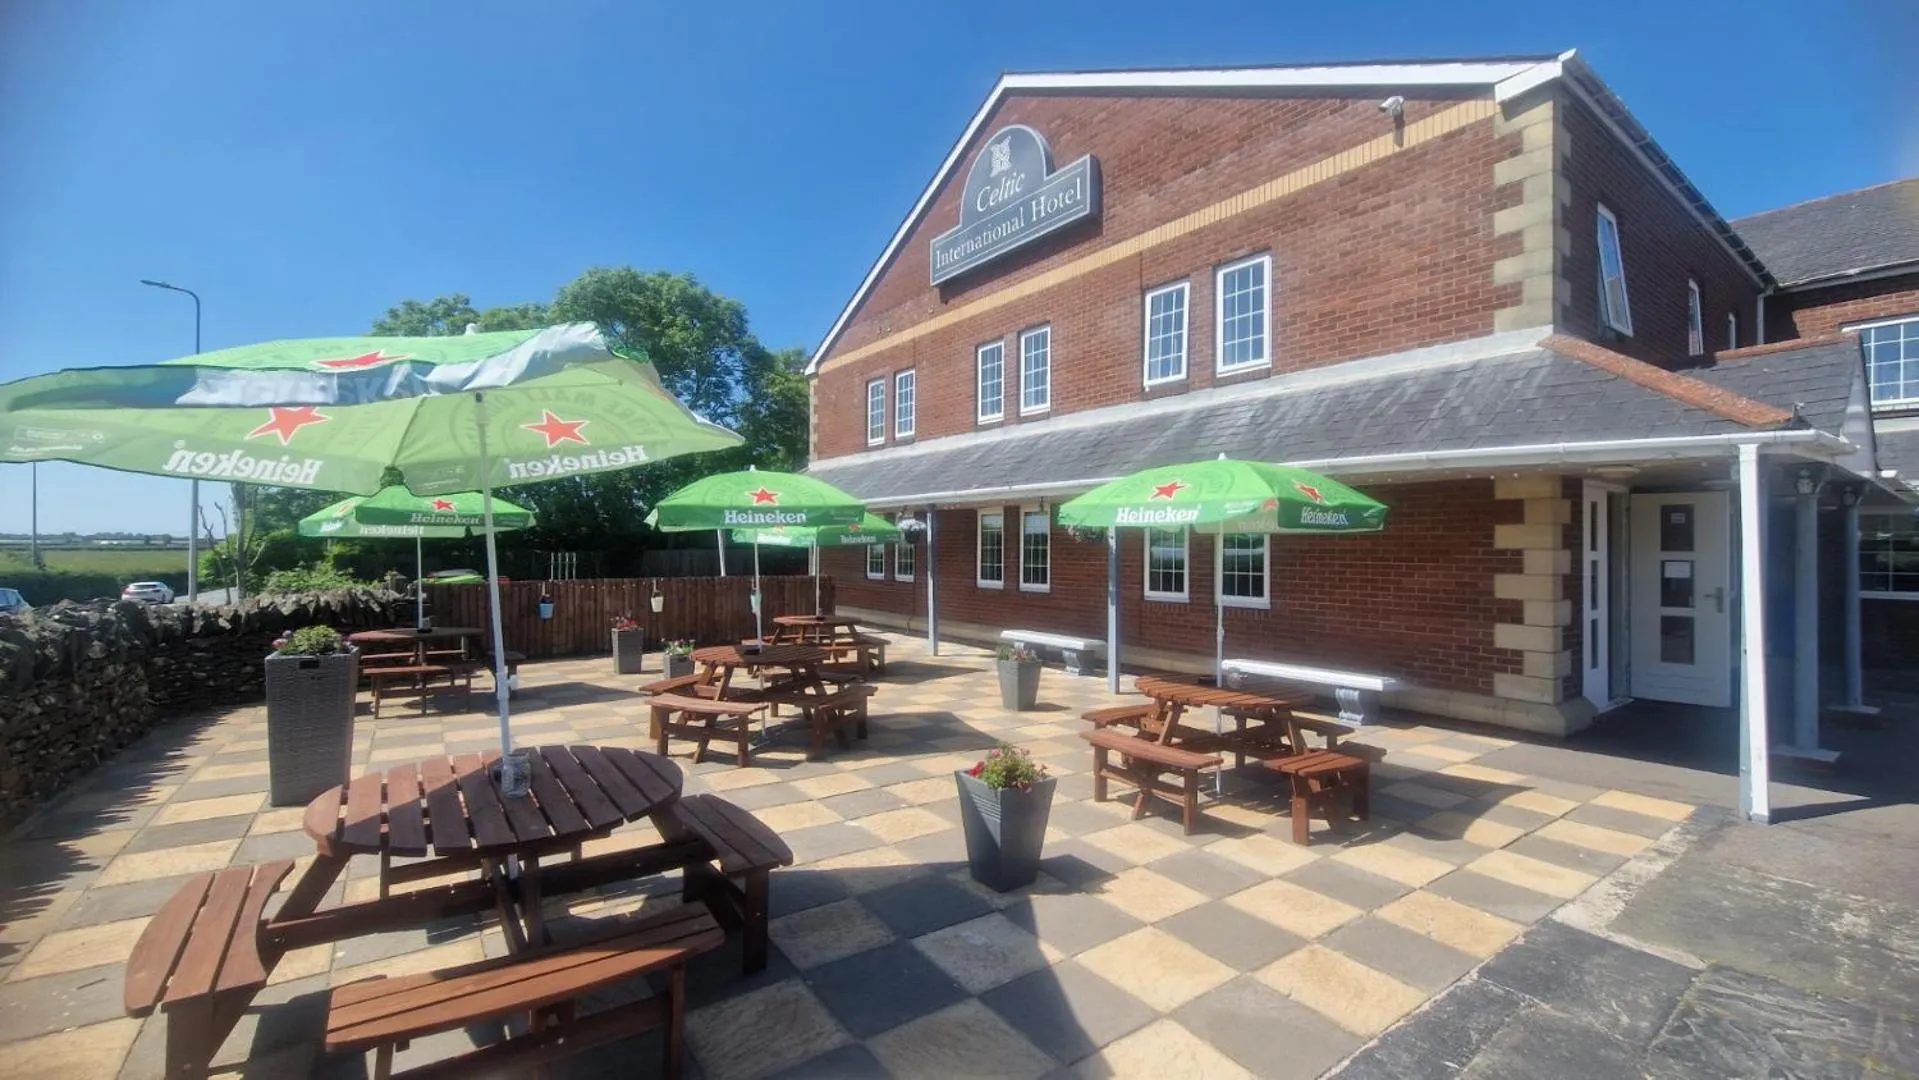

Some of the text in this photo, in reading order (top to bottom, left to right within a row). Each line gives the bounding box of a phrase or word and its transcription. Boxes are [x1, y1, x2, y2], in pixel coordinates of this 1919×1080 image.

[976, 172, 1025, 212] Celtic
[936, 178, 1081, 269] International Hotel
[410, 513, 480, 525] Heineken
[724, 509, 807, 525] Heineken
[1115, 506, 1200, 524] Heineken
[1301, 506, 1349, 525] Heineken
